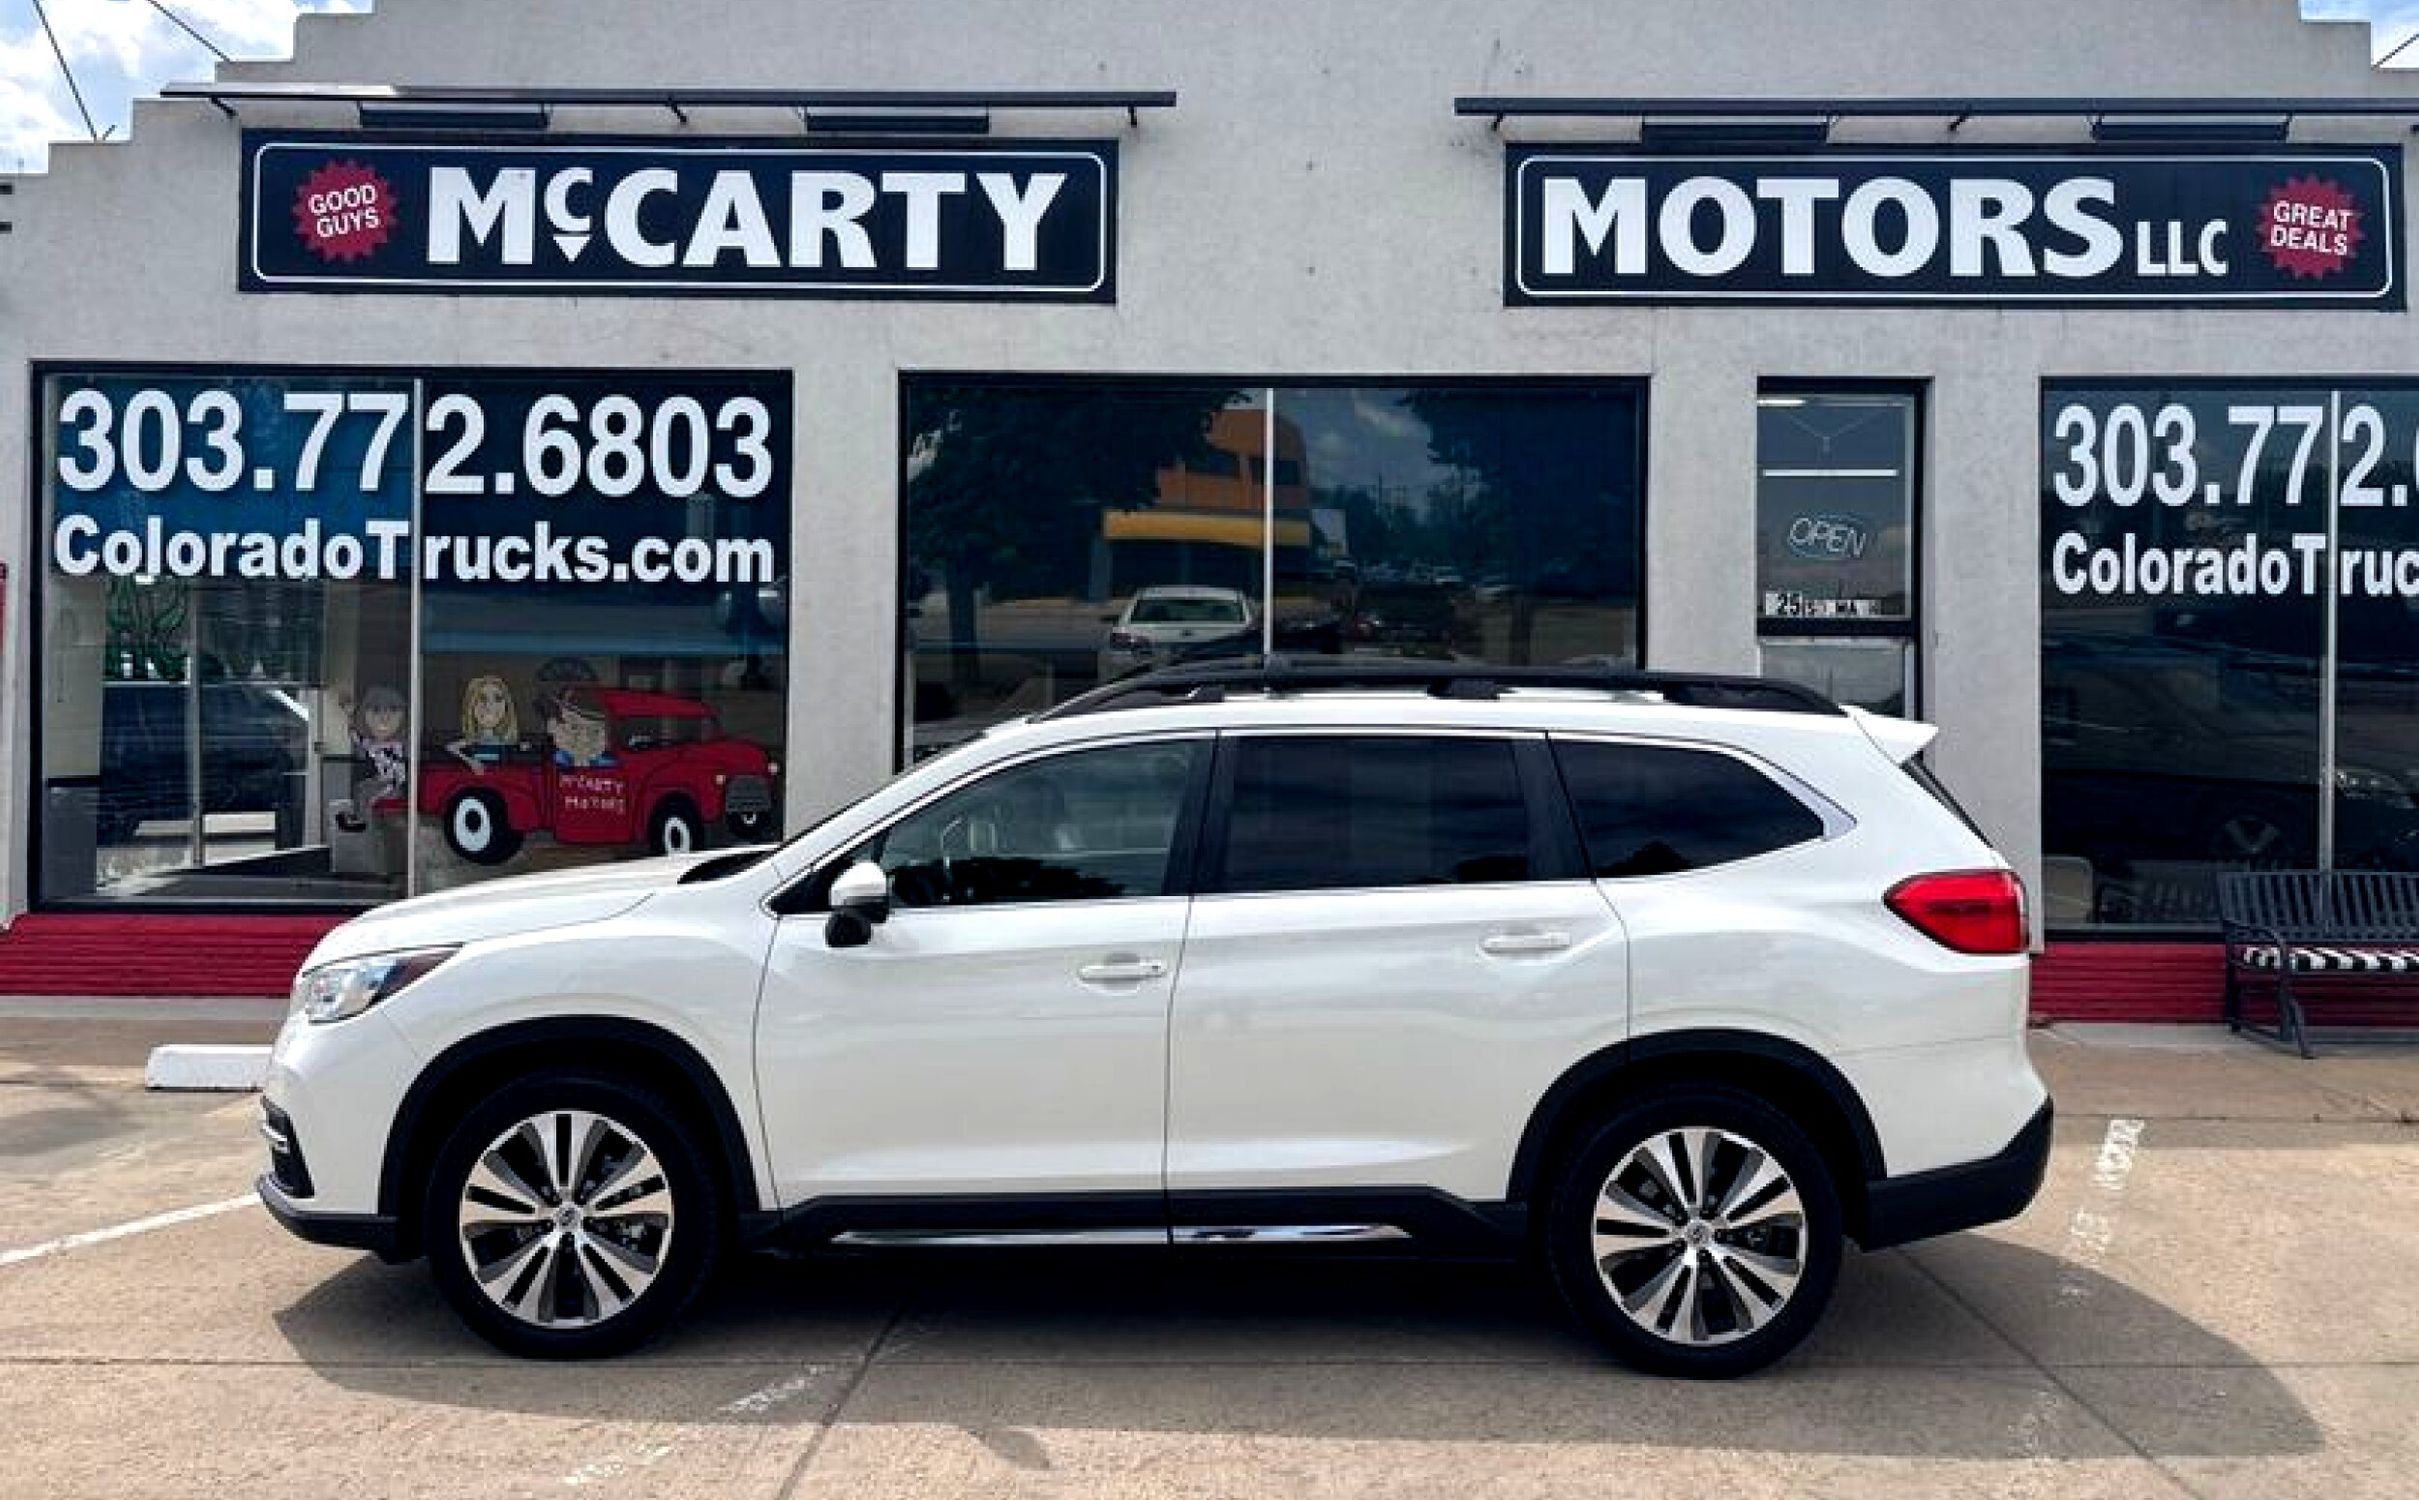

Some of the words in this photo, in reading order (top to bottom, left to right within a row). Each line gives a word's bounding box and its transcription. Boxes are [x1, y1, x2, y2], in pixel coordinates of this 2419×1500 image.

[308, 184, 377, 215] GOOD
[2273, 200, 2353, 231] GREAT
[316, 206, 379, 238] GUYS
[1542, 175, 2124, 277] MOTORS
[2136, 219, 2228, 277] LLC
[2270, 224, 2348, 255] DEALS
[56, 388, 774, 498] 303.772.6803
[2054, 403, 2419, 507] 303.772.
[54, 514, 774, 583] ColoradoTrucks.com
[1789, 517, 1867, 559] OPEN
